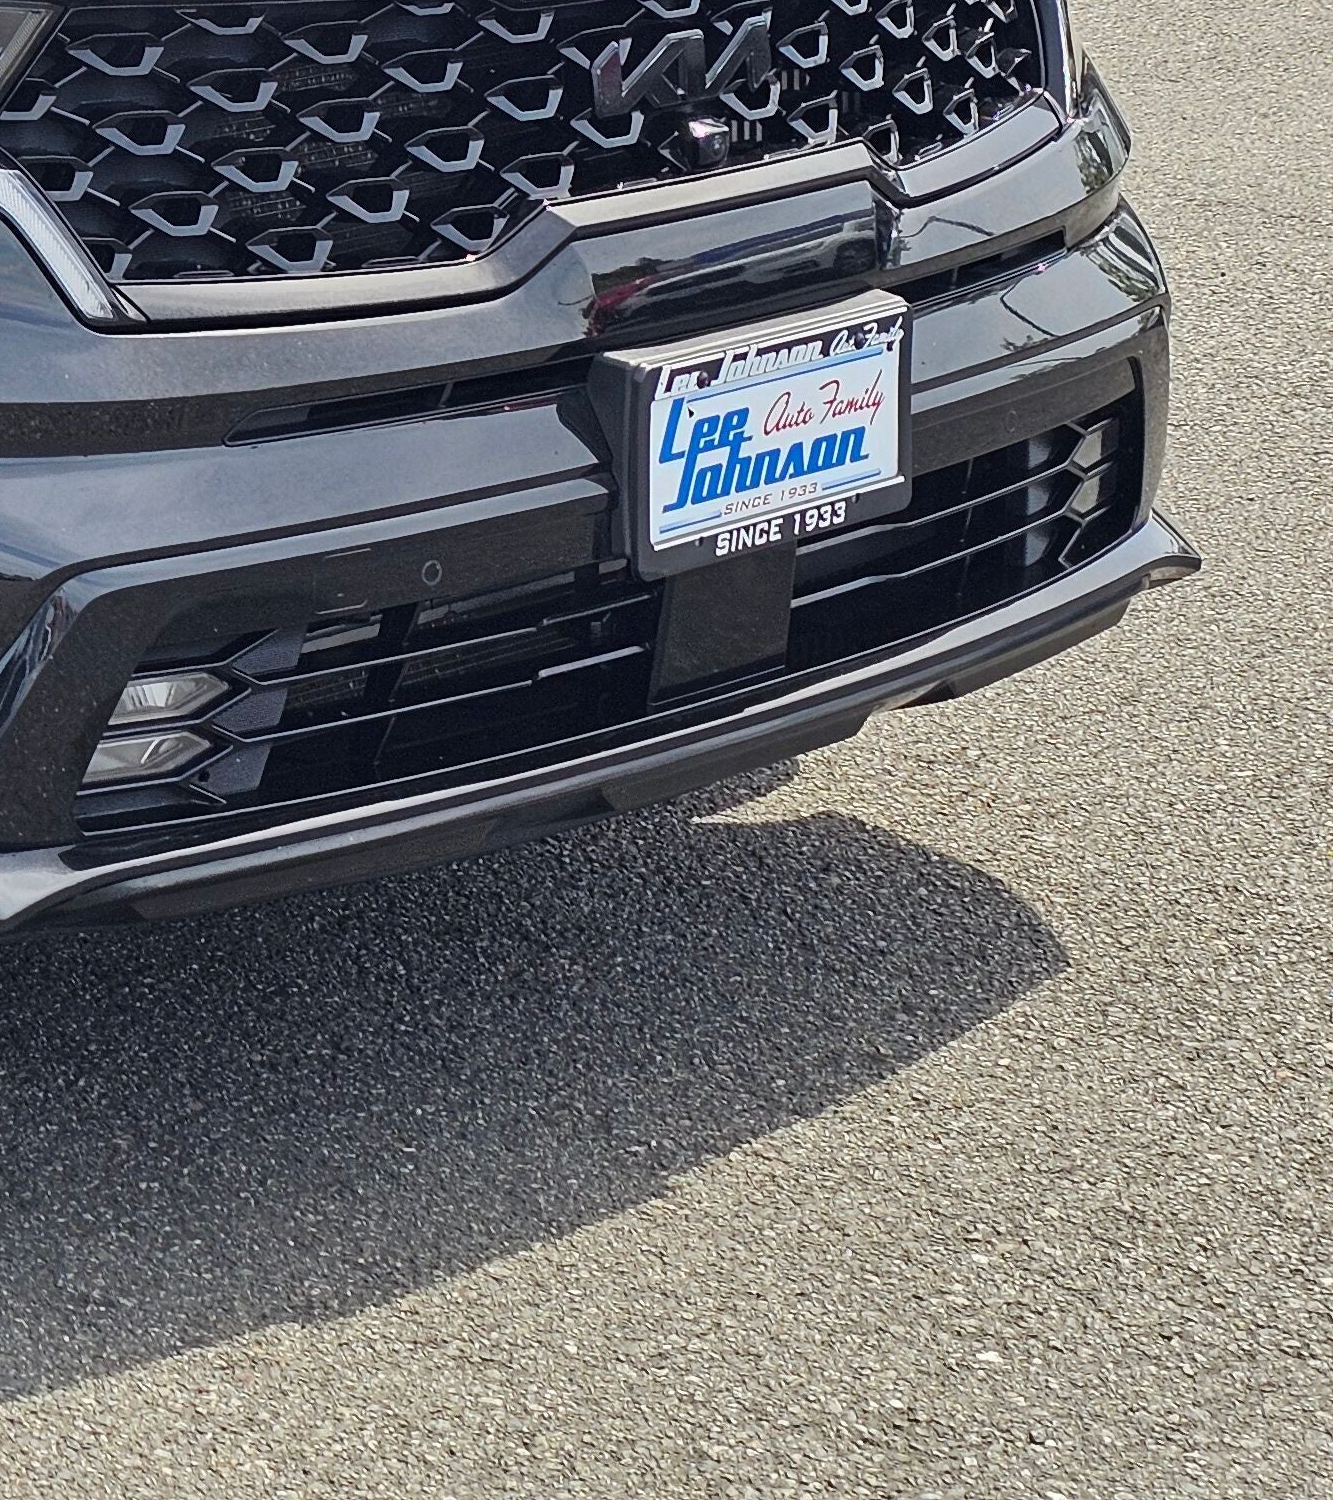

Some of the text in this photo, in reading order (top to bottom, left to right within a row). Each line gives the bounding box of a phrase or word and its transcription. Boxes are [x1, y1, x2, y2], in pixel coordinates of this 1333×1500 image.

[709, 343, 825, 386] Johnson
[830, 329, 864, 357] Aut
[862, 316, 904, 351] Family
[658, 396, 753, 464] Lee
[763, 369, 885, 436] Auto Family
[661, 426, 870, 514] Johnson
[723, 482, 819, 516] SINCE 1933
[715, 500, 848, 557] SINCE 1933
